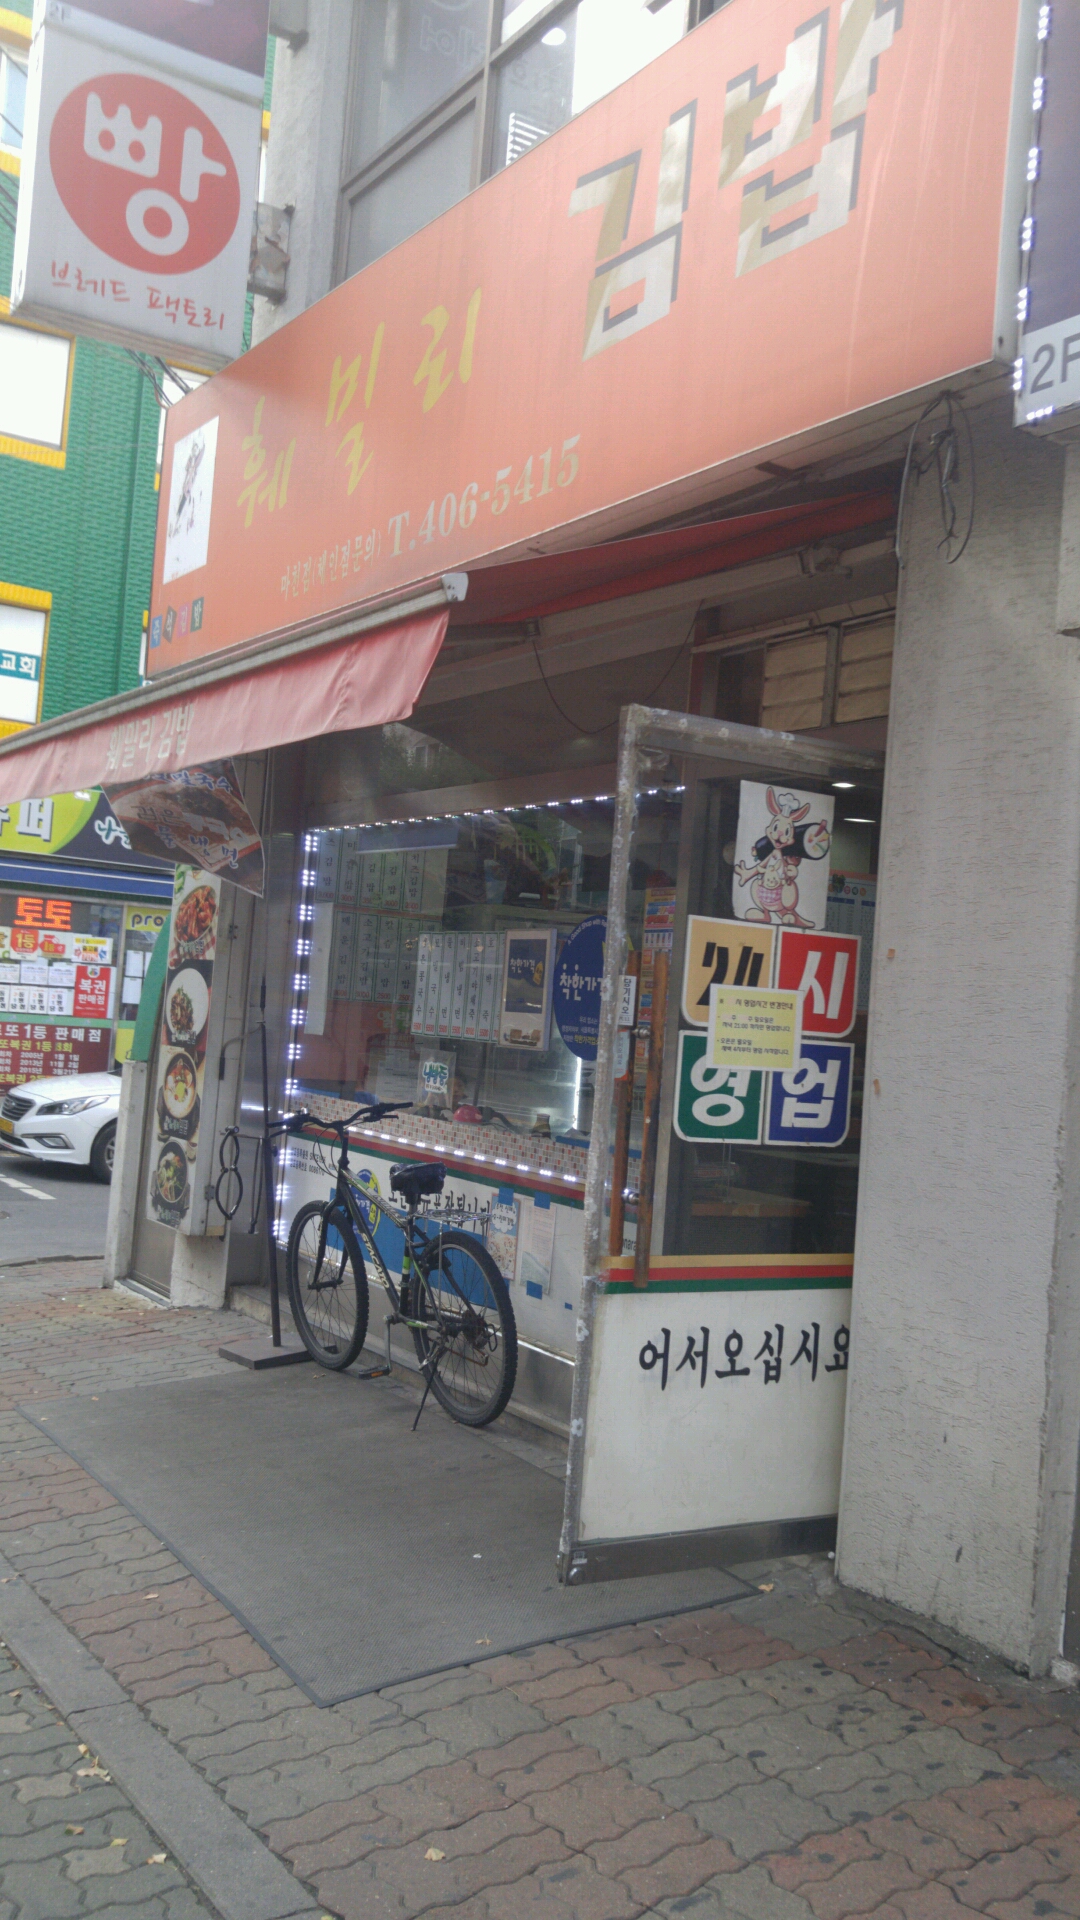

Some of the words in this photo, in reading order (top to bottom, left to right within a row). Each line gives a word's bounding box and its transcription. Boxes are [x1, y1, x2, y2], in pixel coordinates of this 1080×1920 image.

[83, 91, 227, 257] 빵
[567, 0, 905, 362] 김밥
[50, 259, 131, 303] 브레드
[146, 284, 226, 331] 팩토리
[237, 286, 482, 528] 훼밀리
[387, 433, 582, 558] T.406-5415
[0, 652, 37, 679] 교회
[157, 702, 196, 760] 김밥
[14, 896, 72, 930] 토토
[78, 978, 107, 995] 복권
[621, 978, 632, 1015] 당기시오
[24, 1024, 47, 1040] 1등
